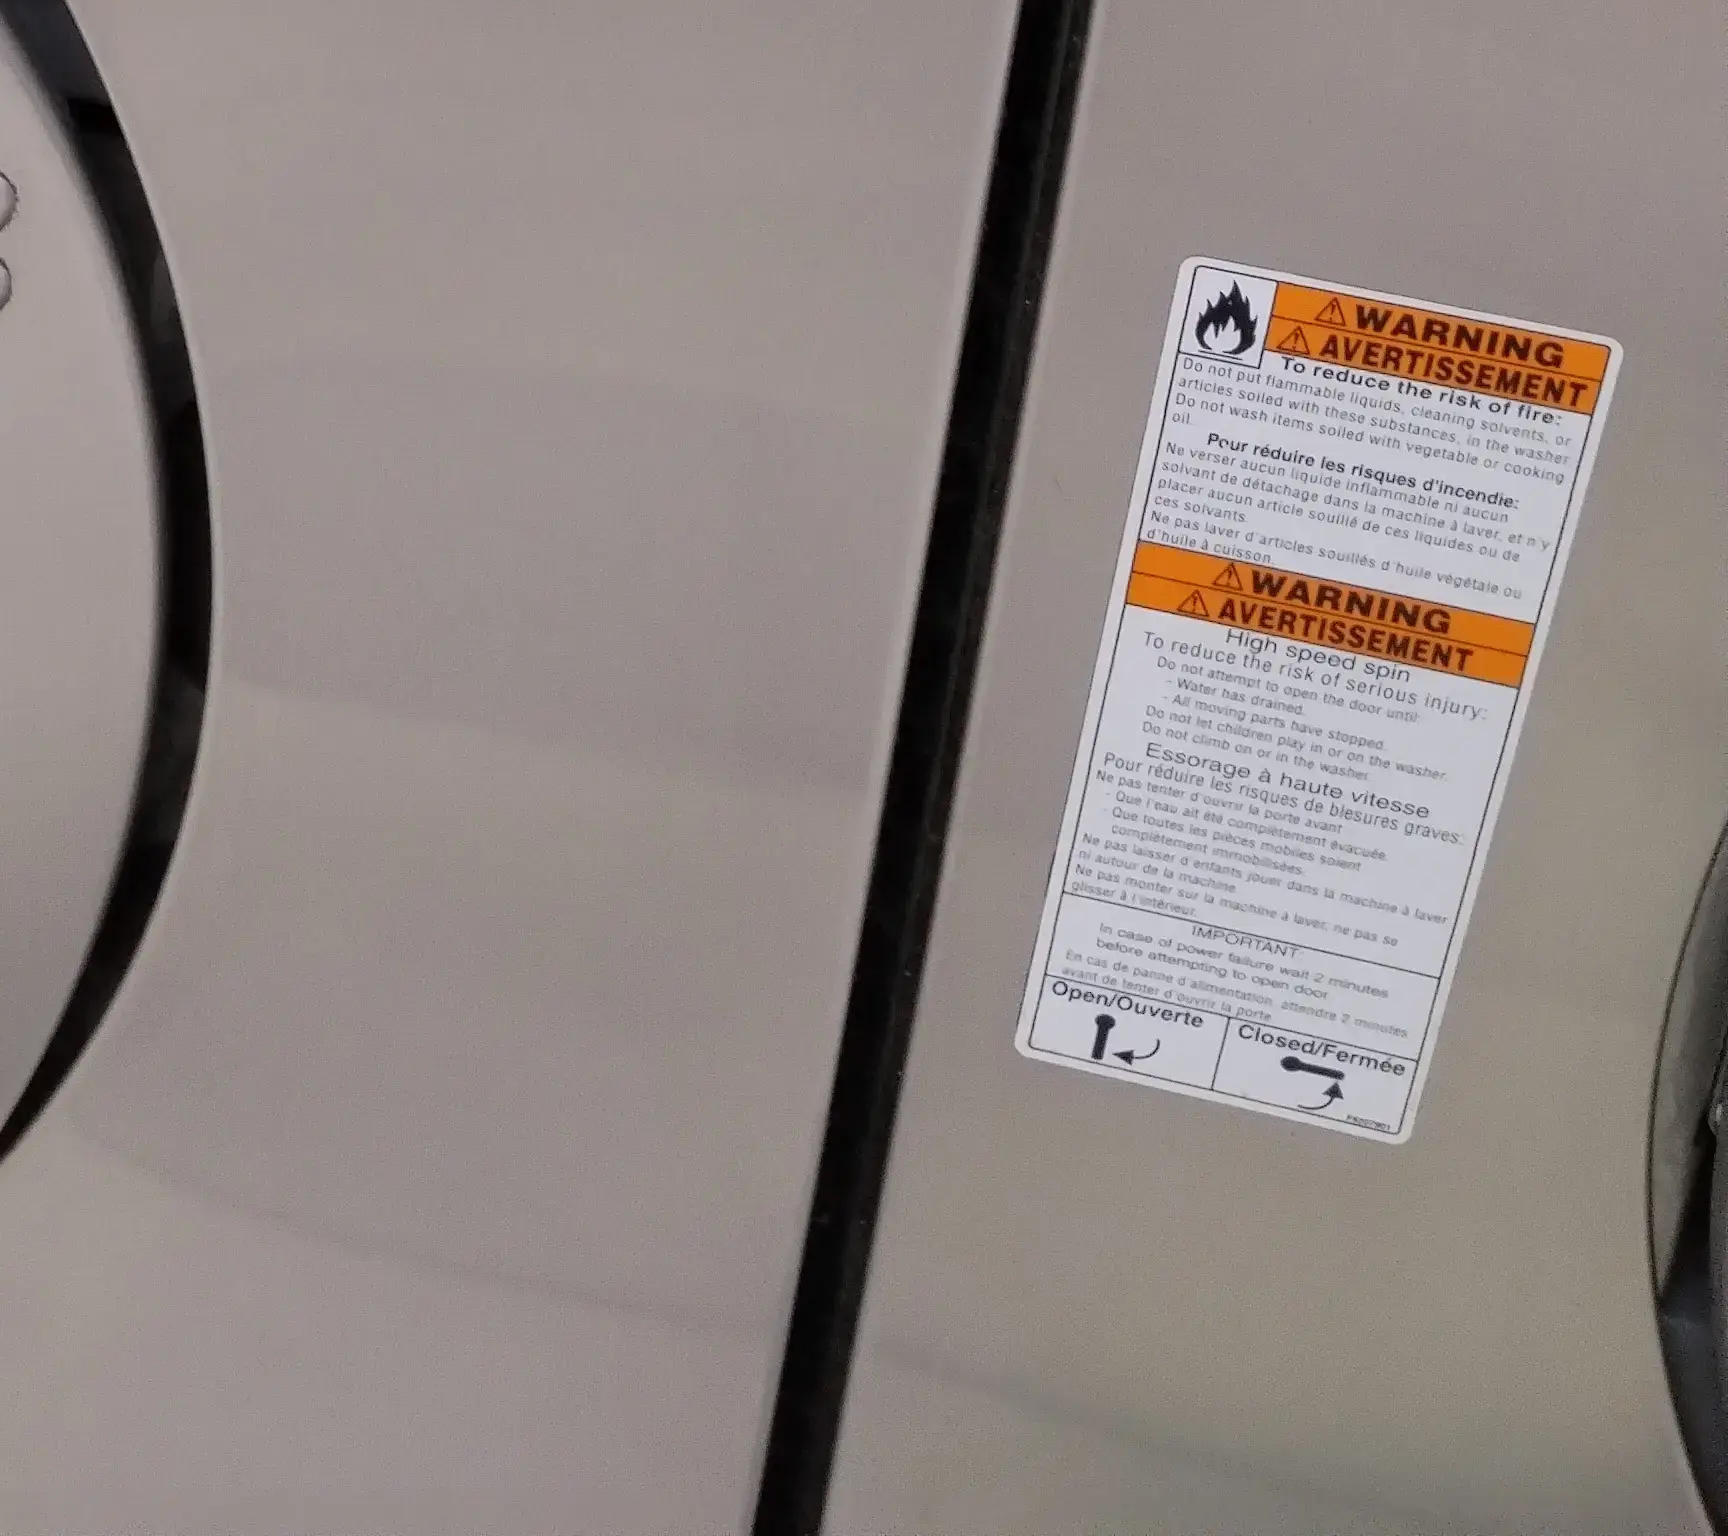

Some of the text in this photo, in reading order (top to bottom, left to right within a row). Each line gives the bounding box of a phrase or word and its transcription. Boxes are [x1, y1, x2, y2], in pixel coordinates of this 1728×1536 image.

[1317, 333, 1590, 409] AVERTISSEMENT
[1354, 302, 1566, 370] WARNING
[1177, 376, 1234, 398] articles
[1237, 388, 1285, 409] soiled
[1287, 399, 1321, 416] with
[1323, 404, 1367, 426] these
[1465, 433, 1482, 448] in
[1484, 437, 1511, 455] the
[1182, 355, 1204, 374] Do
[1206, 364, 1234, 380] not
[1234, 369, 1263, 386] put
[1264, 373, 1347, 403] flammable
[1409, 404, 1477, 431] cleaning
[1554, 434, 1573, 448] or
[1280, 354, 1565, 427] To reduce the risk of fire:
[1174, 391, 1566, 487] Do not wash items soiled with vegetable or cooking
[1205, 431, 1520, 511] Pour réduire les risques d'incendie:
[1153, 494, 1180, 510] ces
[1160, 460, 1218, 482] solvant
[1218, 470, 1239, 487] de
[1240, 475, 1320, 504] détachage
[1322, 492, 1361, 512] dans
[1362, 499, 1378, 516] la
[1164, 440, 1186, 458] Ne
[1188, 448, 1238, 468] verser
[1238, 458, 1287, 478] aucun
[1289, 466, 1343, 490] liquide
[1461, 504, 1510, 524] aucun
[1149, 508, 1171, 526] Ne
[1172, 516, 1201, 532] pas
[1203, 520, 1242, 540] laver
[1502, 585, 1523, 601] ou
[1156, 477, 1206, 497] placer
[1206, 487, 1254, 508] aucun
[1255, 497, 1305, 518] article
[1360, 518, 1382, 535] de
[1383, 524, 1411, 541] ces
[1413, 528, 1475, 554] liquides
[1477, 544, 1499, 559] ou
[1500, 548, 1522, 564] de
[1216, 596, 1475, 673] AVERTISSEMENT
[1250, 568, 1453, 636] WARNING
[1143, 630, 1166, 651] To
[1169, 639, 1238, 666] reduce
[1241, 652, 1274, 674] the
[1277, 661, 1316, 684] risk
[1319, 671, 1343, 689] of
[1344, 677, 1419, 707] serious
[1224, 628, 1412, 684] High speed spin
[1102, 750, 1145, 774] Pour
[1146, 762, 1206, 788] réduire
[1208, 774, 1234, 795] les
[1237, 783, 1300, 810] risques
[1302, 796, 1325, 815] de
[1144, 741, 1252, 780] Essorage
[1278, 770, 1345, 801] haute
[1350, 789, 1431, 820] vitesse
[1050, 979, 1205, 1029] Open/Ouverte
[1237, 1022, 1407, 1078] Closed/Fermée
